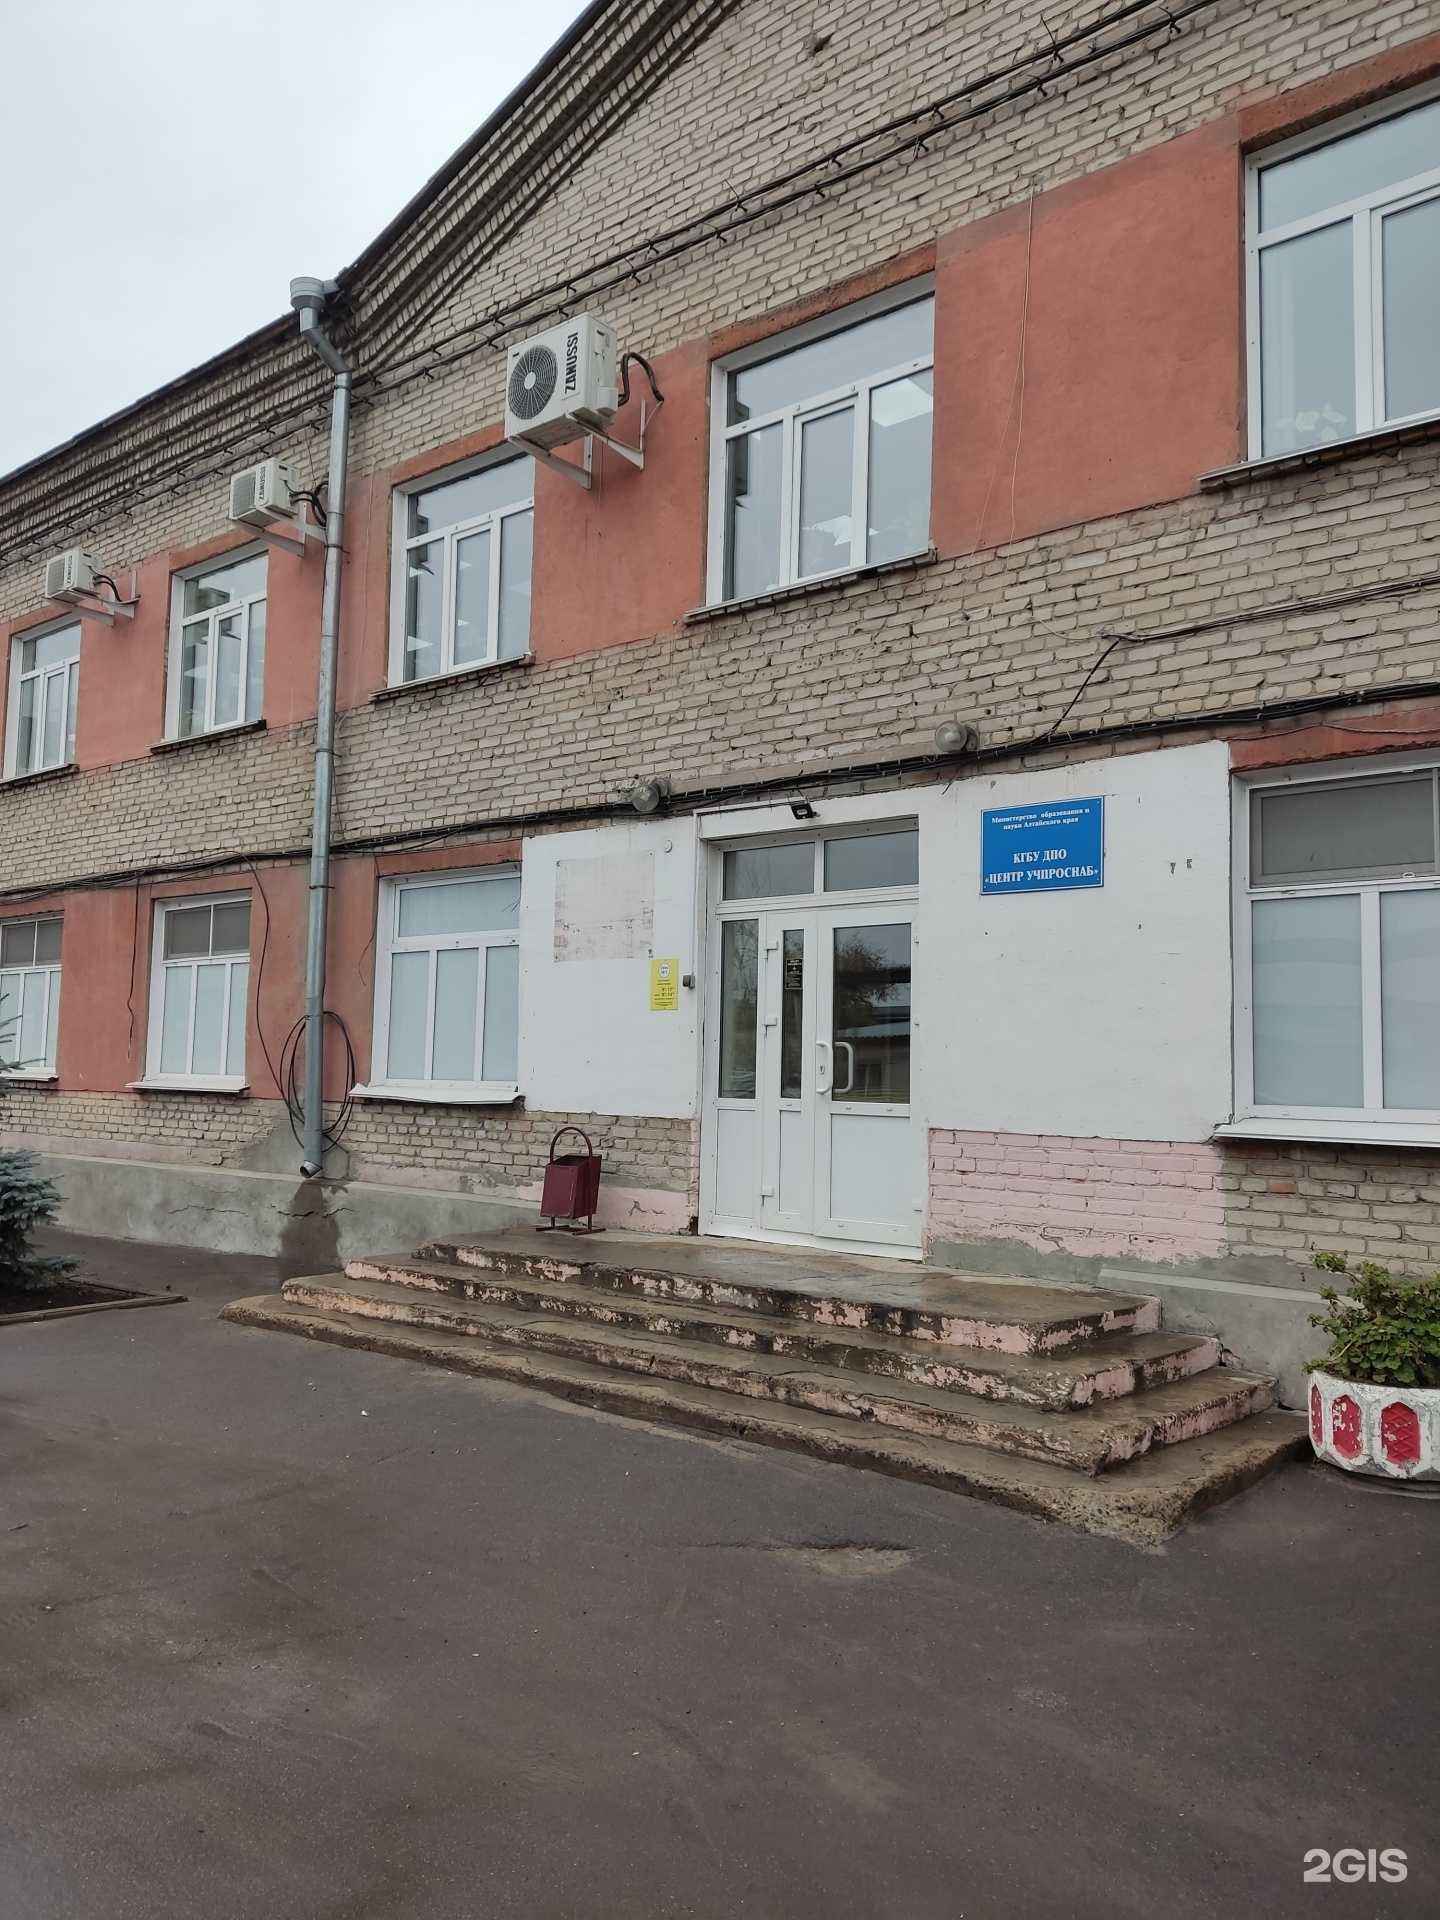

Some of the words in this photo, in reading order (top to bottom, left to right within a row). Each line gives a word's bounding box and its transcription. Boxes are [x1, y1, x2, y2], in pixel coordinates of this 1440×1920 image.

[564, 332, 579, 394] ZANUSSI
[991, 813, 1038, 824] Министерство
[1040, 808, 1084, 820] образования
[1003, 823, 1023, 831] науки
[1023, 818, 1062, 829] Алтайского
[1062, 816, 1079, 825] края
[1013, 850, 1040, 864] КГБУ
[1042, 848, 1067, 863] ДПО
[984, 871, 1024, 885] «ЦЕНТР
[1026, 865, 1099, 881] УЧПРОСНАБ»
